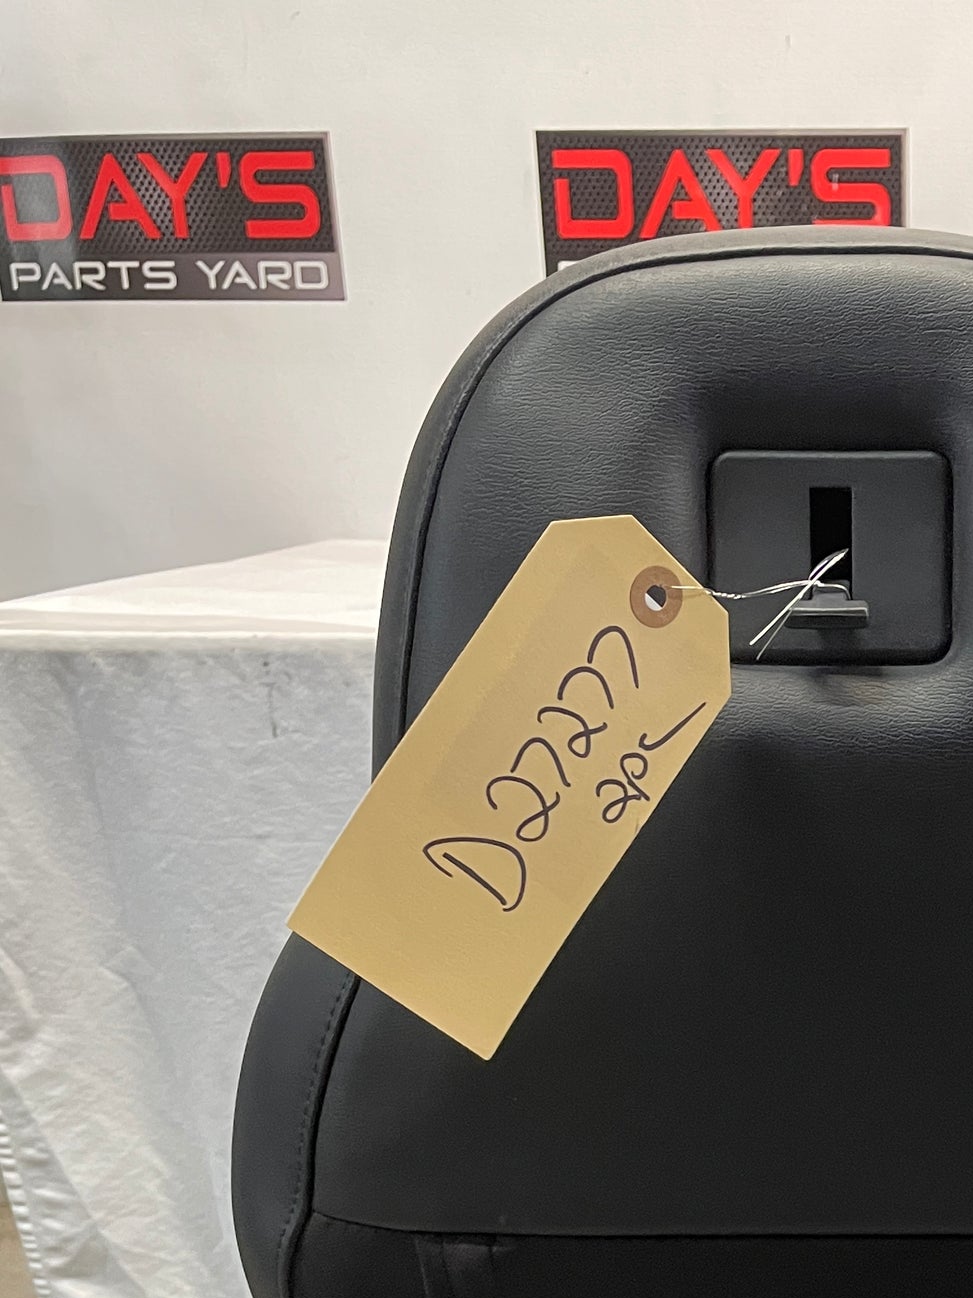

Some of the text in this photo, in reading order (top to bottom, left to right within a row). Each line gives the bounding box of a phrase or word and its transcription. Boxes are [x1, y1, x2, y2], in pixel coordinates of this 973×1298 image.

[0, 151, 321, 241] DAY'S
[551, 148, 891, 239] DAY'S
[9, 260, 329, 291] PARTS YARD
[422, 625, 639, 913] D27277
